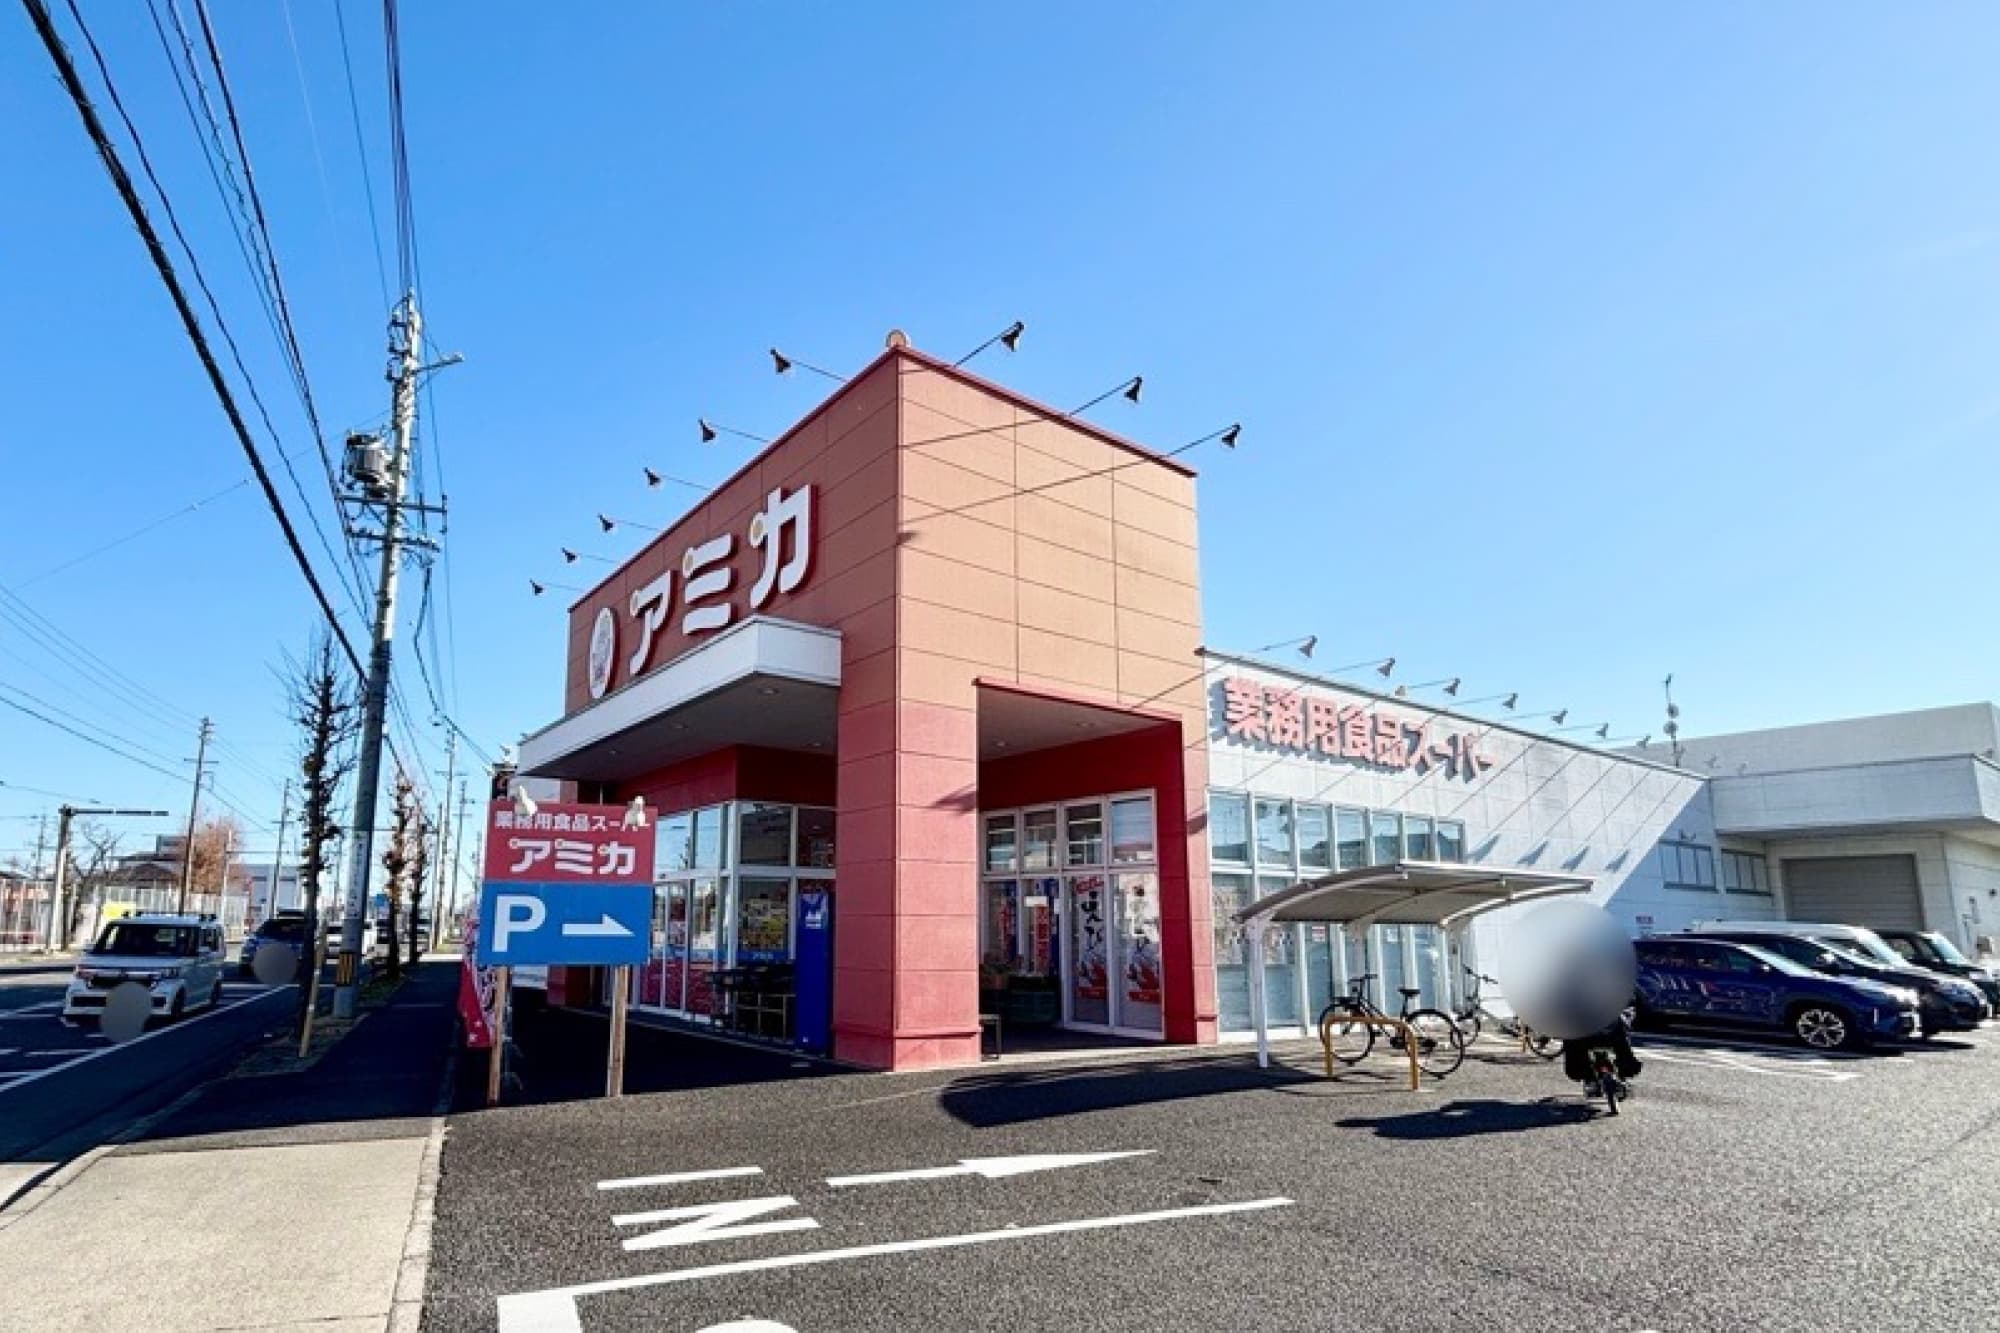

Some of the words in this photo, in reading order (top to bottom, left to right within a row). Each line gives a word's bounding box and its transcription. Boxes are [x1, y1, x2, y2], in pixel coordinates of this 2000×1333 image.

[630, 484, 811, 675] アミカ
[1224, 677, 1496, 778] 業務用食品スーパー
[509, 838, 636, 875] アミカ
[492, 895, 546, 952] P
